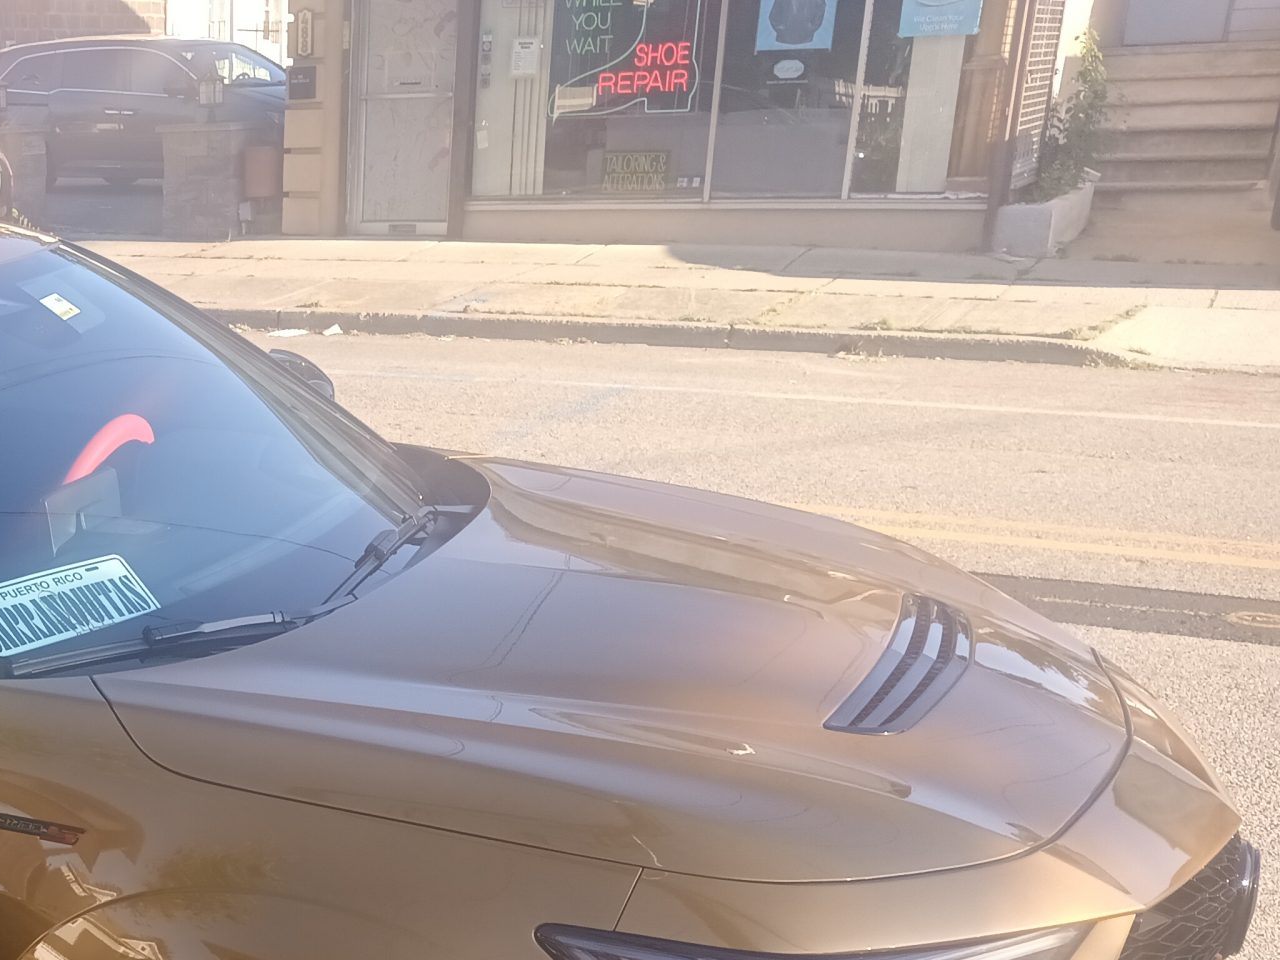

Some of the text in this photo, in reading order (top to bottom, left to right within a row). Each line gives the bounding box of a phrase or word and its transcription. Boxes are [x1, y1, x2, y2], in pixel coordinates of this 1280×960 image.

[571, 12, 610, 30] YOU
[566, 35, 613, 54] WAIT
[634, 42, 690, 67] SHOE
[598, 69, 688, 95] REPAIR
[604, 153, 666, 173] TAILORING &
[602, 173, 665, 190] ALTERATIONS
[0, 572, 83, 601] PUERTO RICO
